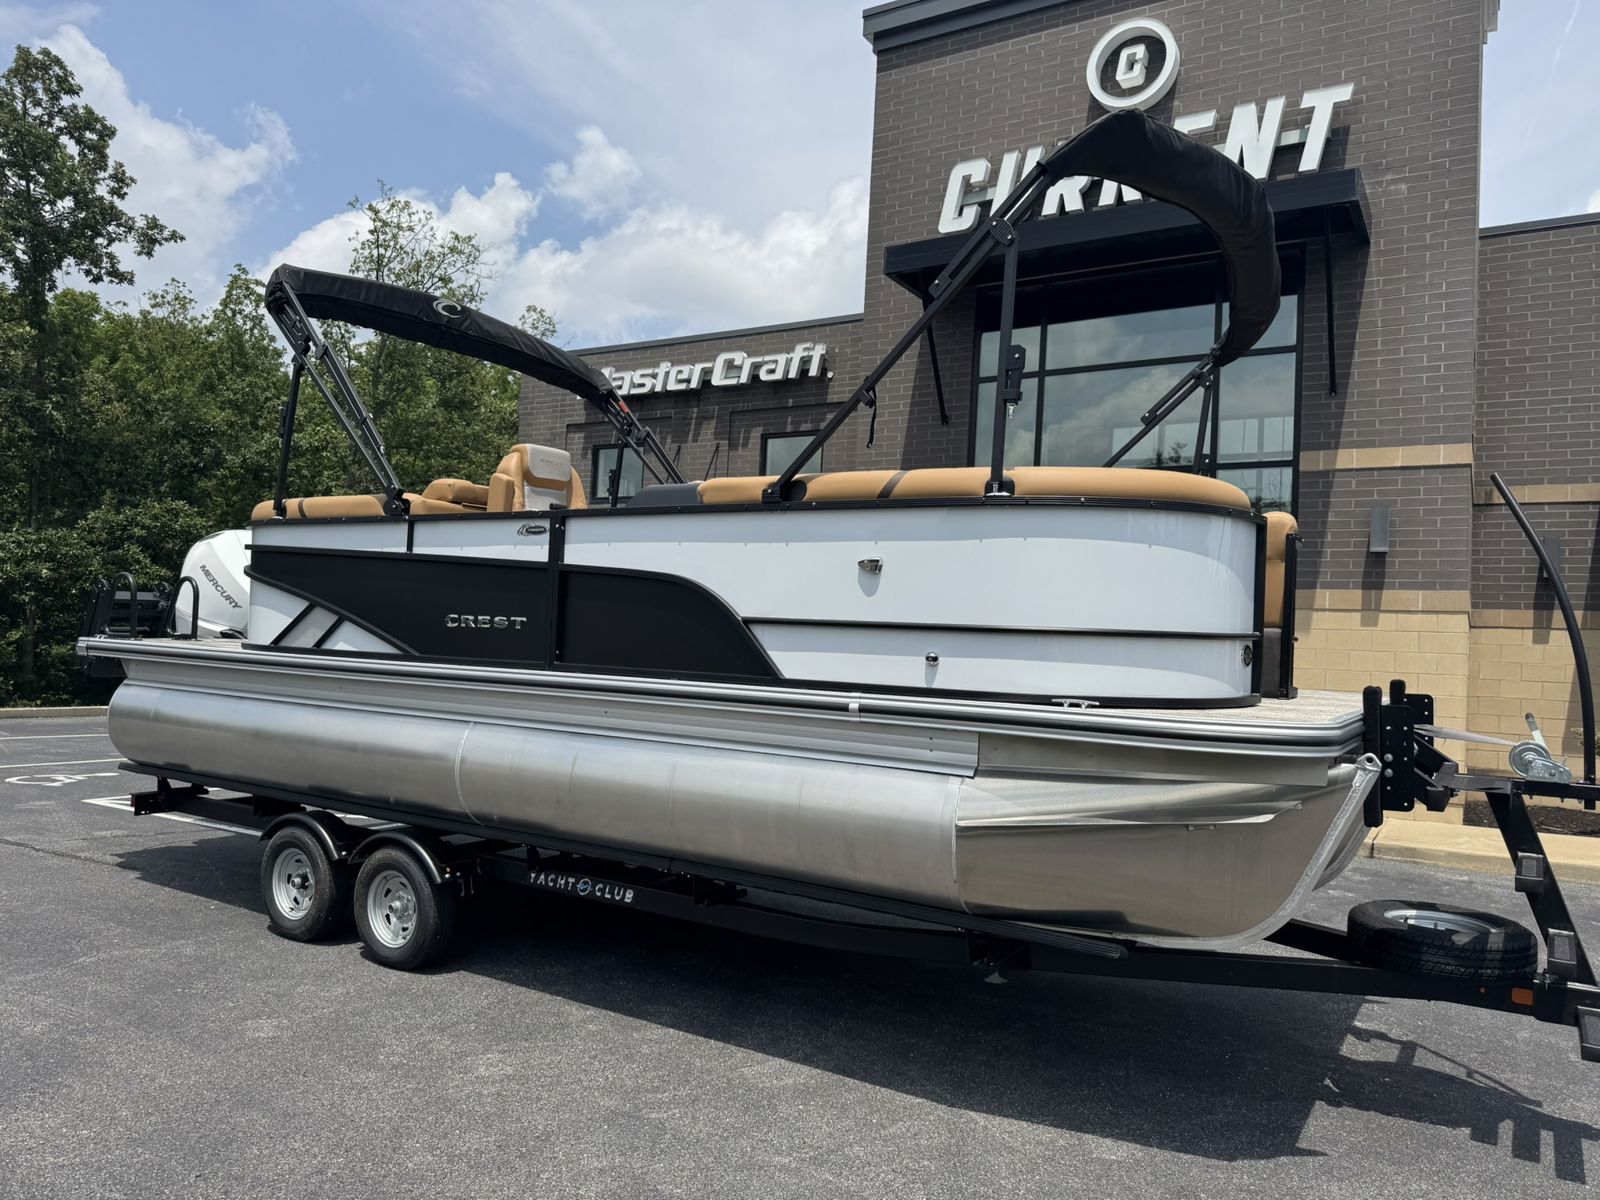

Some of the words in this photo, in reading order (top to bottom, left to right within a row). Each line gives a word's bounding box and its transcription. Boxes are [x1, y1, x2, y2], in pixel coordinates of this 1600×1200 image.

[1116, 43, 1149, 89] C
[577, 341, 827, 399] asterCraft
[200, 564, 243, 610] MERCURY
[445, 613, 527, 629] CREST
[530, 872, 575, 890] YACHT
[595, 883, 634, 902] CLUB
